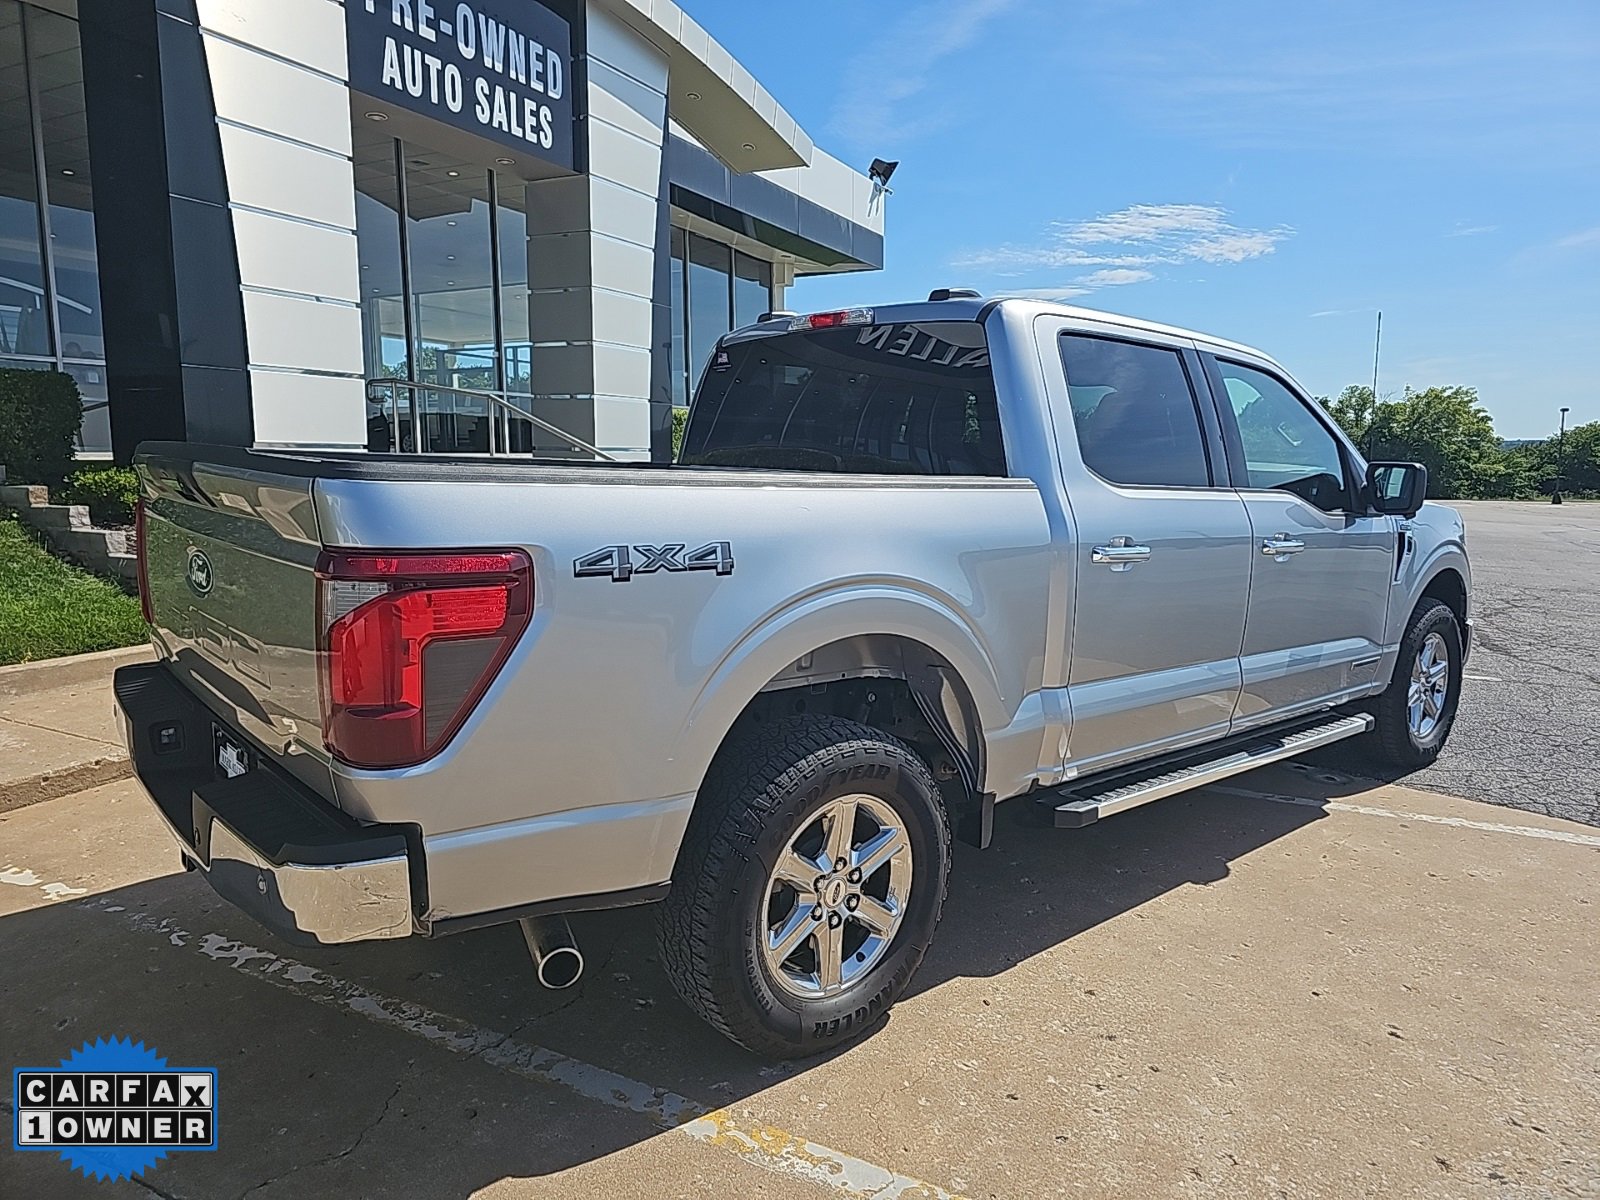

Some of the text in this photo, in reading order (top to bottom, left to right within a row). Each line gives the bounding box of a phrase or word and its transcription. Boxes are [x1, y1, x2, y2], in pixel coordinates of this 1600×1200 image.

[365, 0, 562, 100] RE-OWNED
[382, 36, 553, 149] AUTO SALES
[191, 556, 208, 587] Ford
